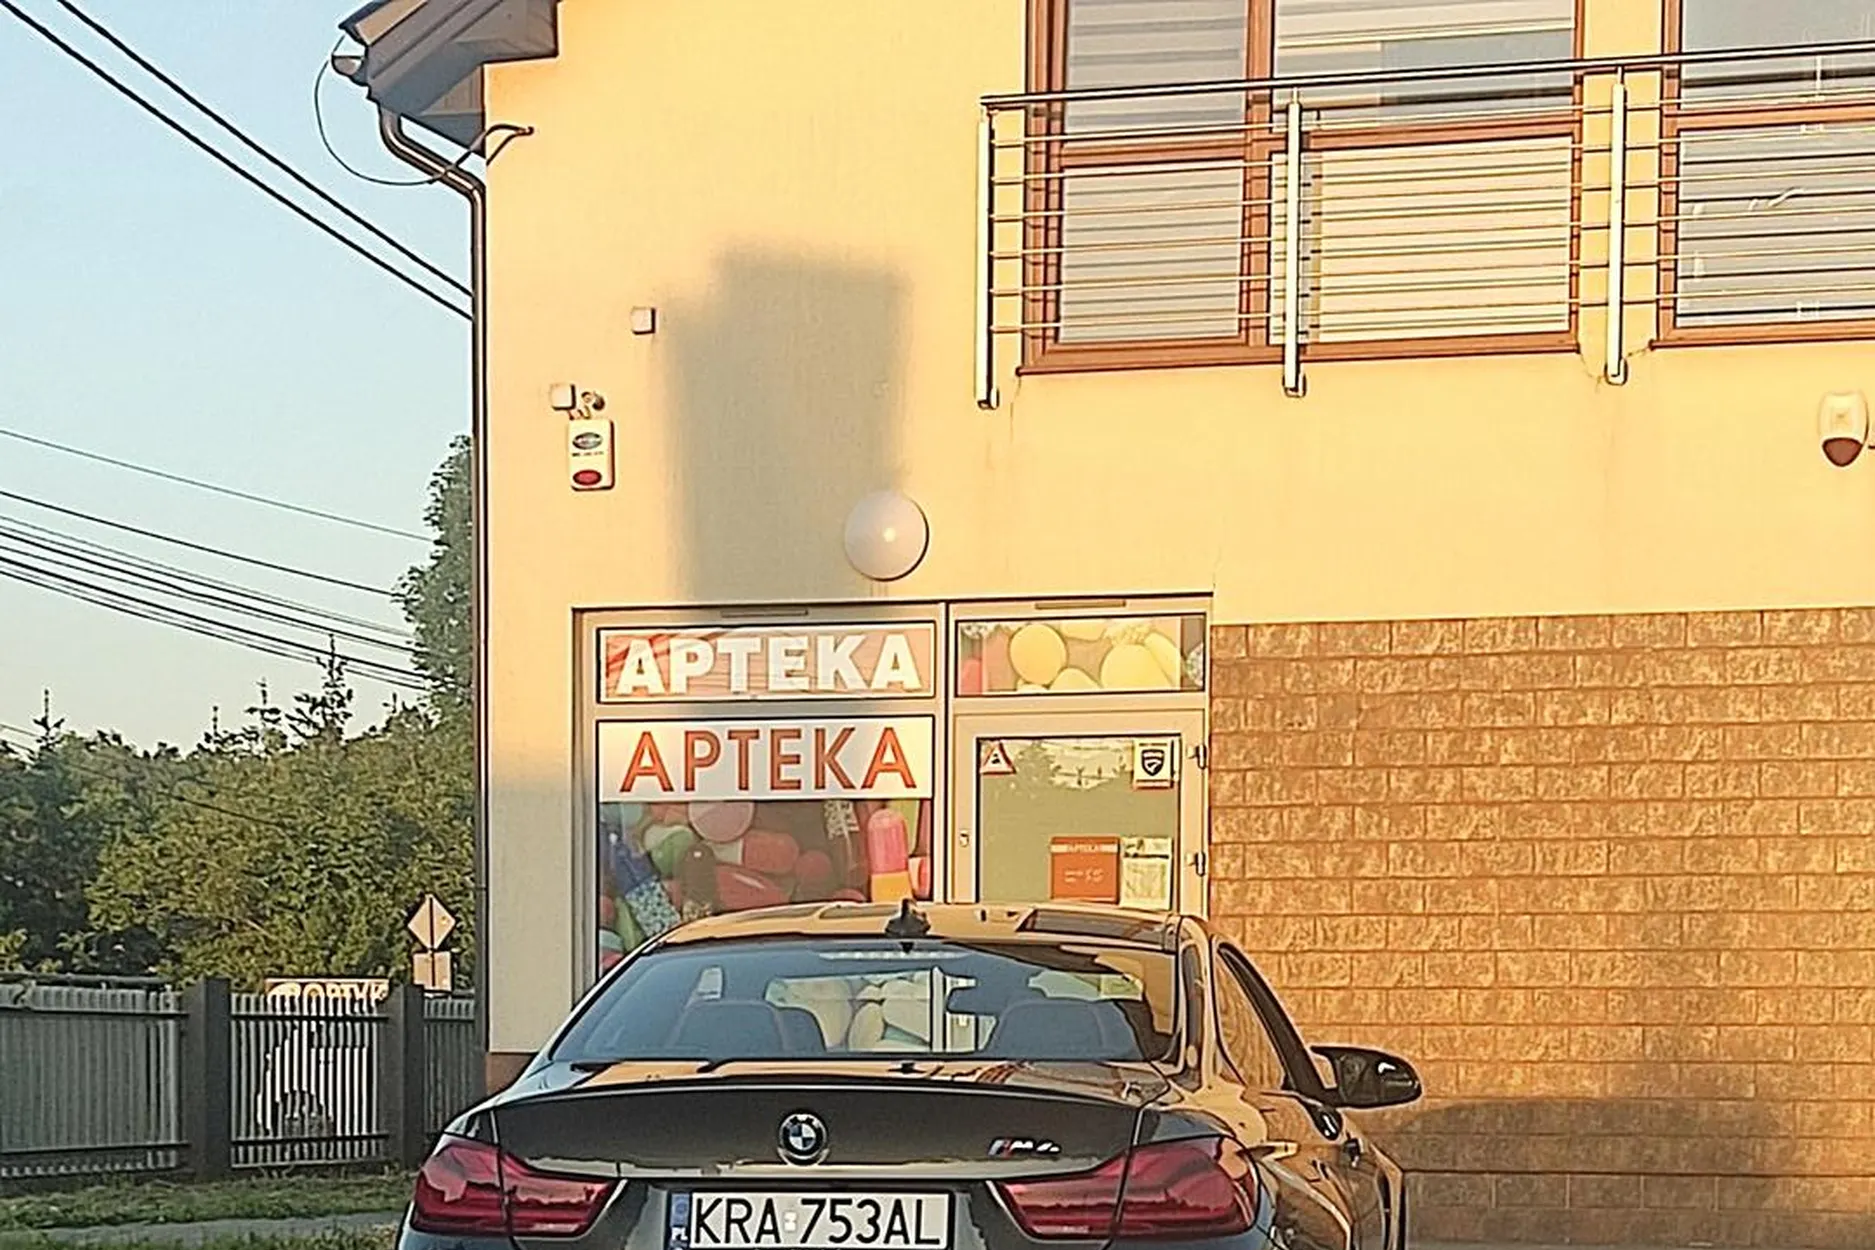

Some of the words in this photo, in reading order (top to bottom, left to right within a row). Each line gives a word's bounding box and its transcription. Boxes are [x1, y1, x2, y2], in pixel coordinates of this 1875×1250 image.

[614, 633, 922, 695] APTEKA
[619, 727, 917, 793] APTEKA
[671, 1227, 688, 1241] PL
[695, 1198, 781, 1244] KRA
[800, 1198, 940, 1245] 753AL
